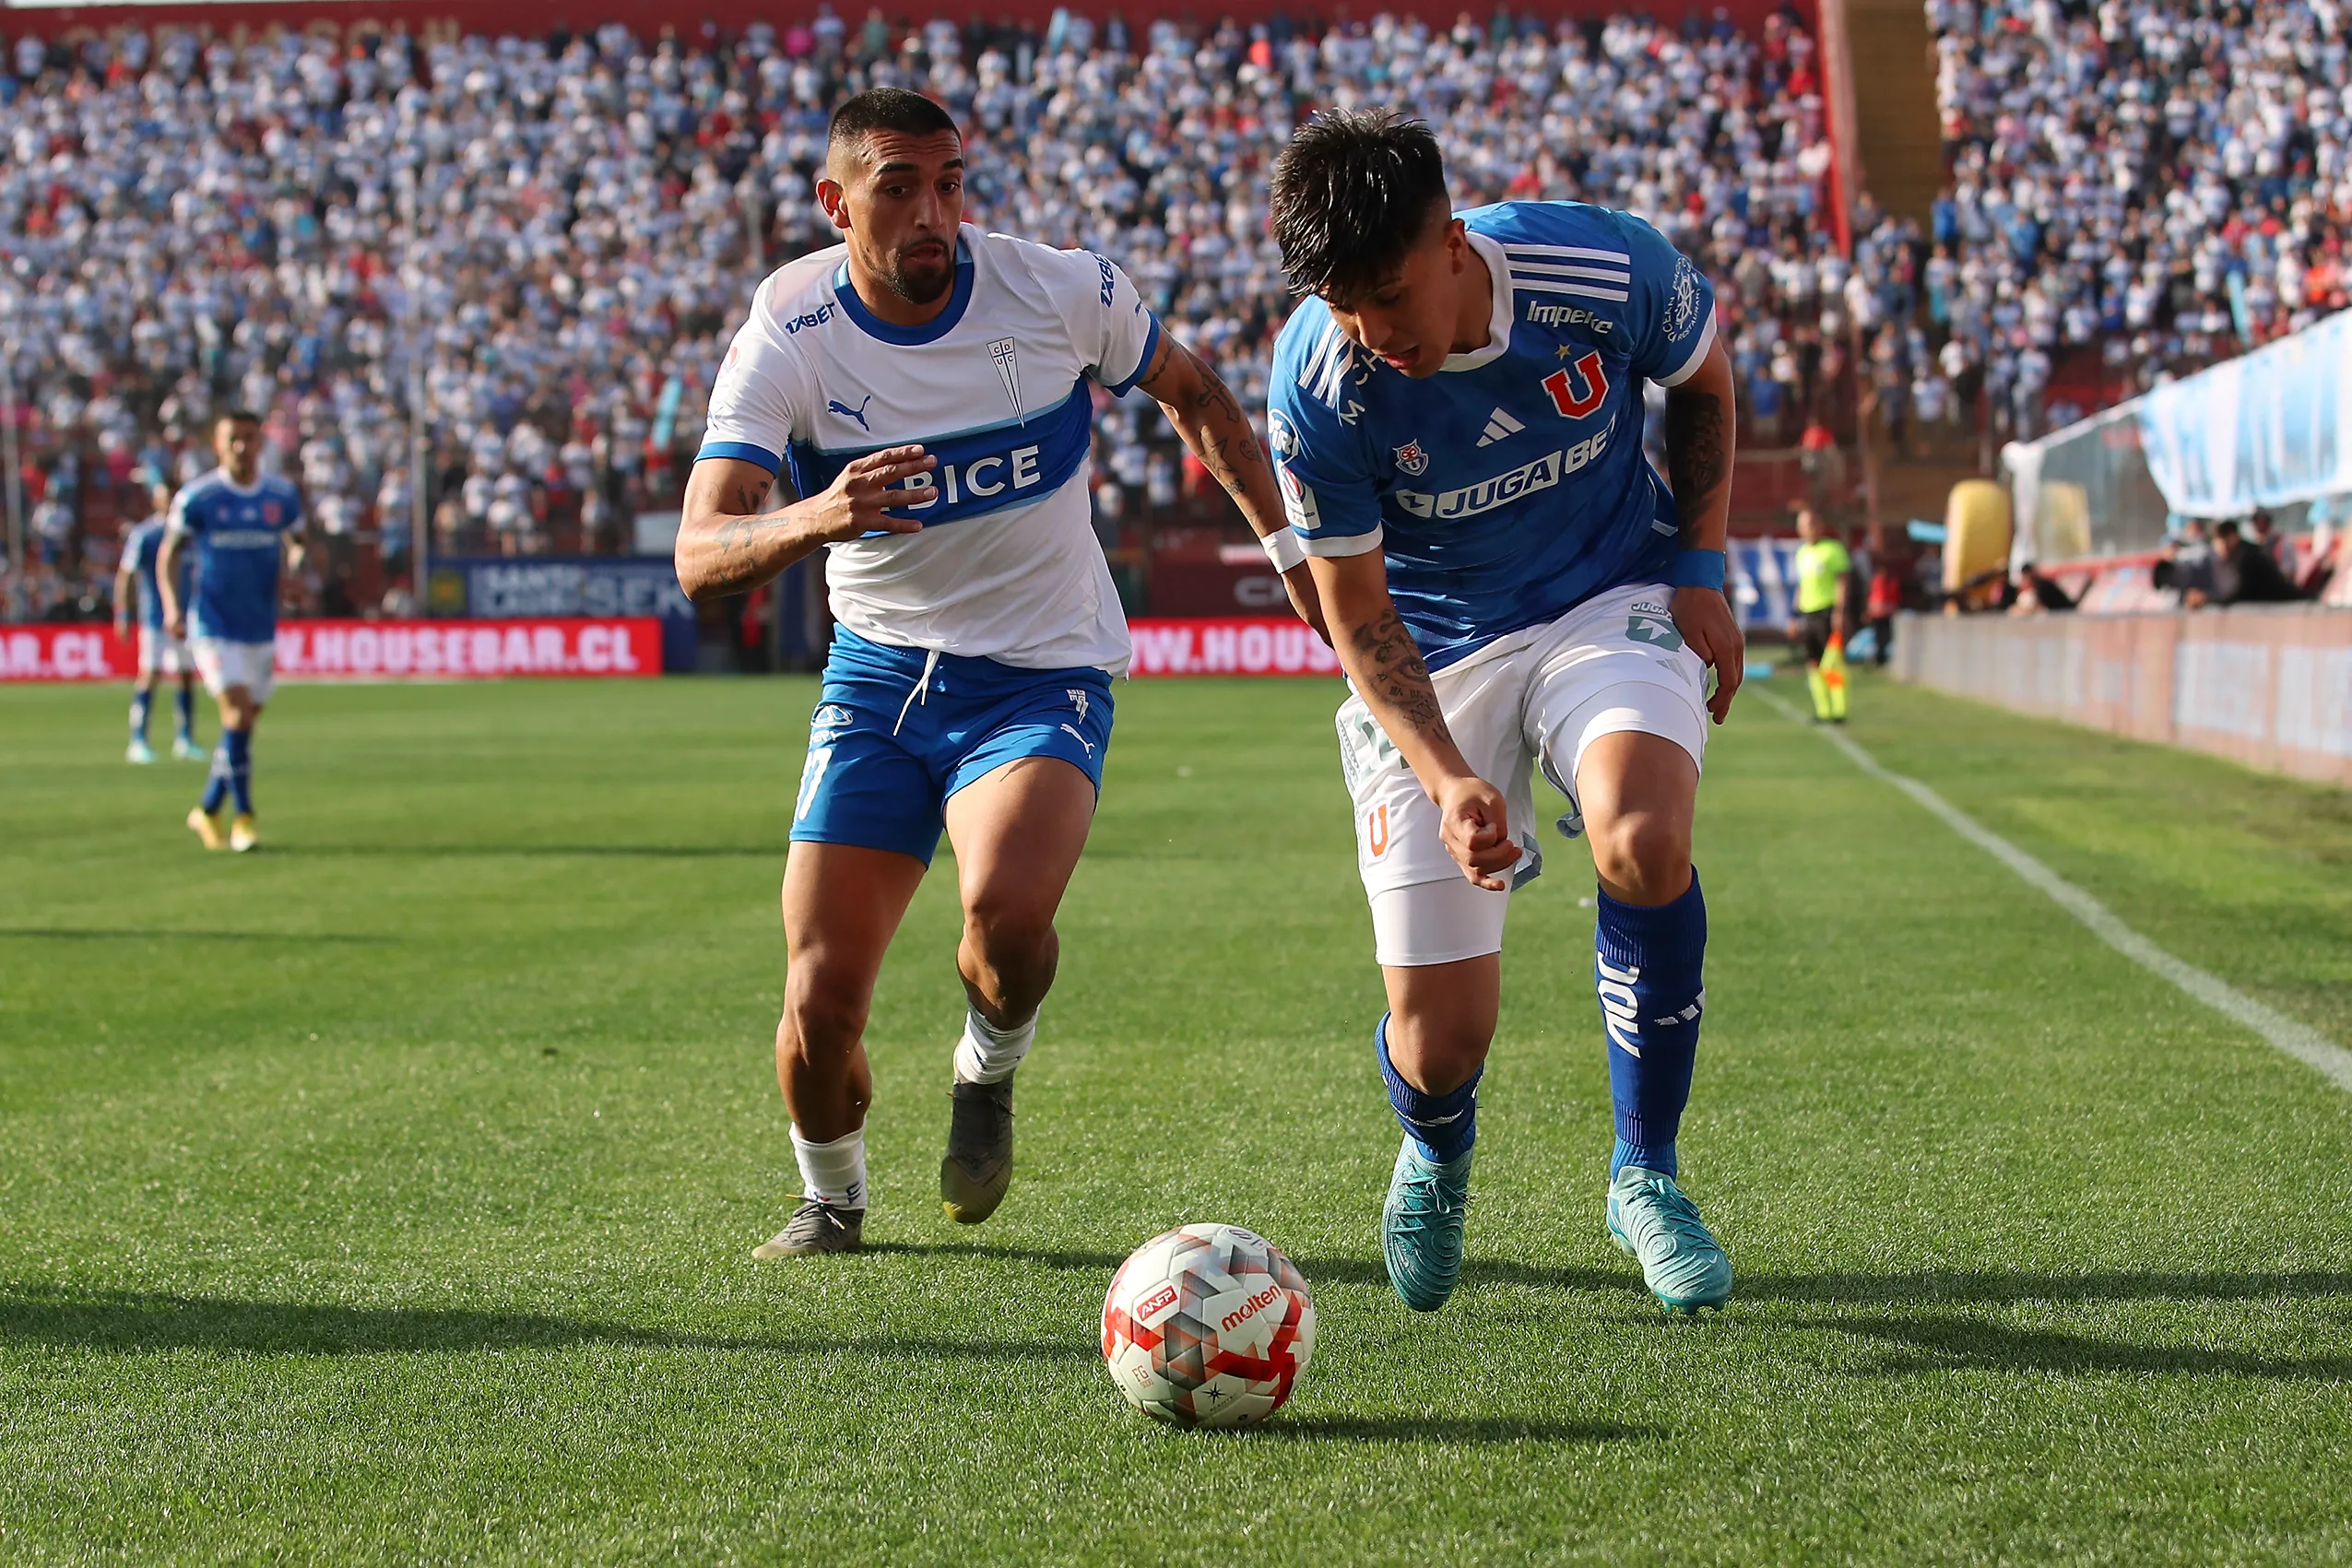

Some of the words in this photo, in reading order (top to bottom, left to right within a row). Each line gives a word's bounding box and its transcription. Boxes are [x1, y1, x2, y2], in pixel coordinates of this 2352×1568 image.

[1092, 253, 1115, 308] 1XBE
[785, 301, 835, 335] 1XBET
[1527, 301, 1613, 334] Impeke
[1541, 349, 1610, 420] U
[904, 444, 1041, 511] BICE
[0, 631, 113, 678] R.CL
[1369, 803, 1389, 857] U
[1141, 1289, 1174, 1318] ANFP
[1221, 1283, 1282, 1333] molten
[1131, 1364, 1150, 1383] FG
